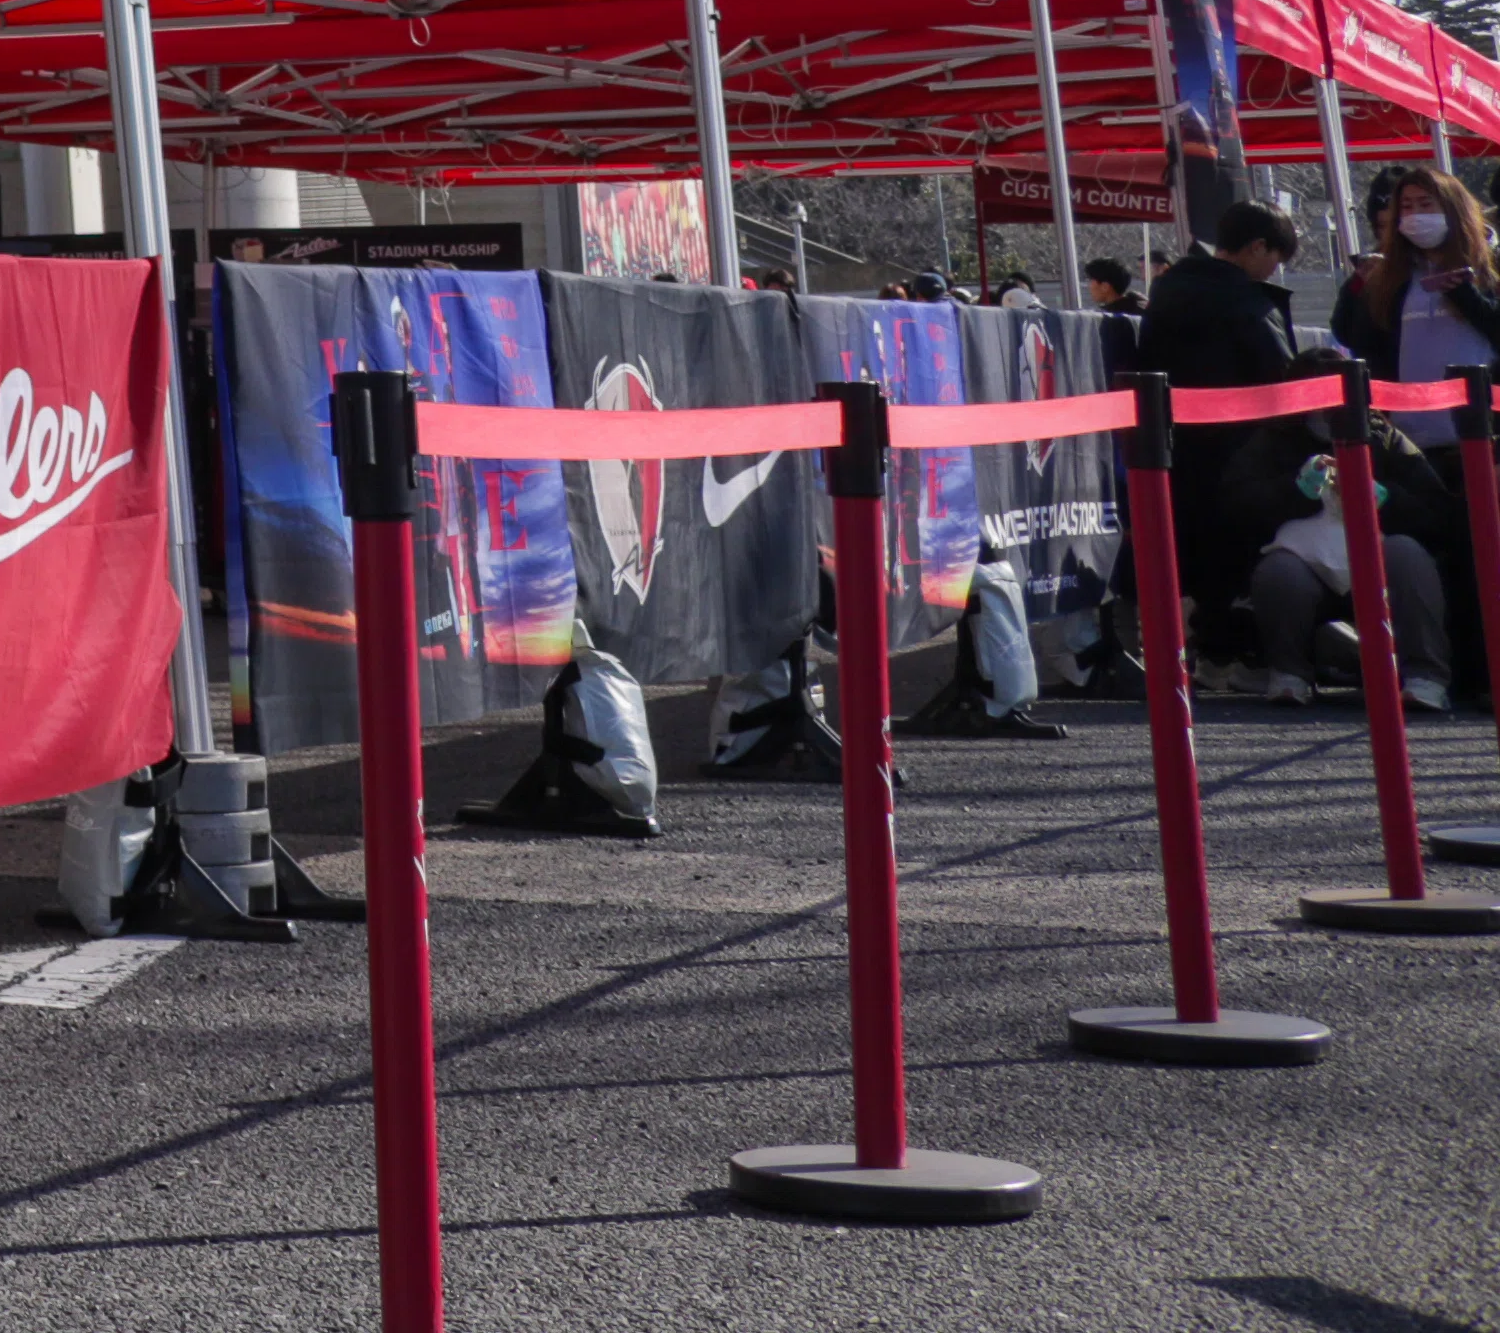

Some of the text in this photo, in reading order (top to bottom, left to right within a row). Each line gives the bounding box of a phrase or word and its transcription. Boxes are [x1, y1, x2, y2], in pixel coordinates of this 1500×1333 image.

[1001, 180, 1082, 204] CUSTM
[367, 243, 430, 260] STADIUM
[431, 241, 501, 258] FLAGSHIP
